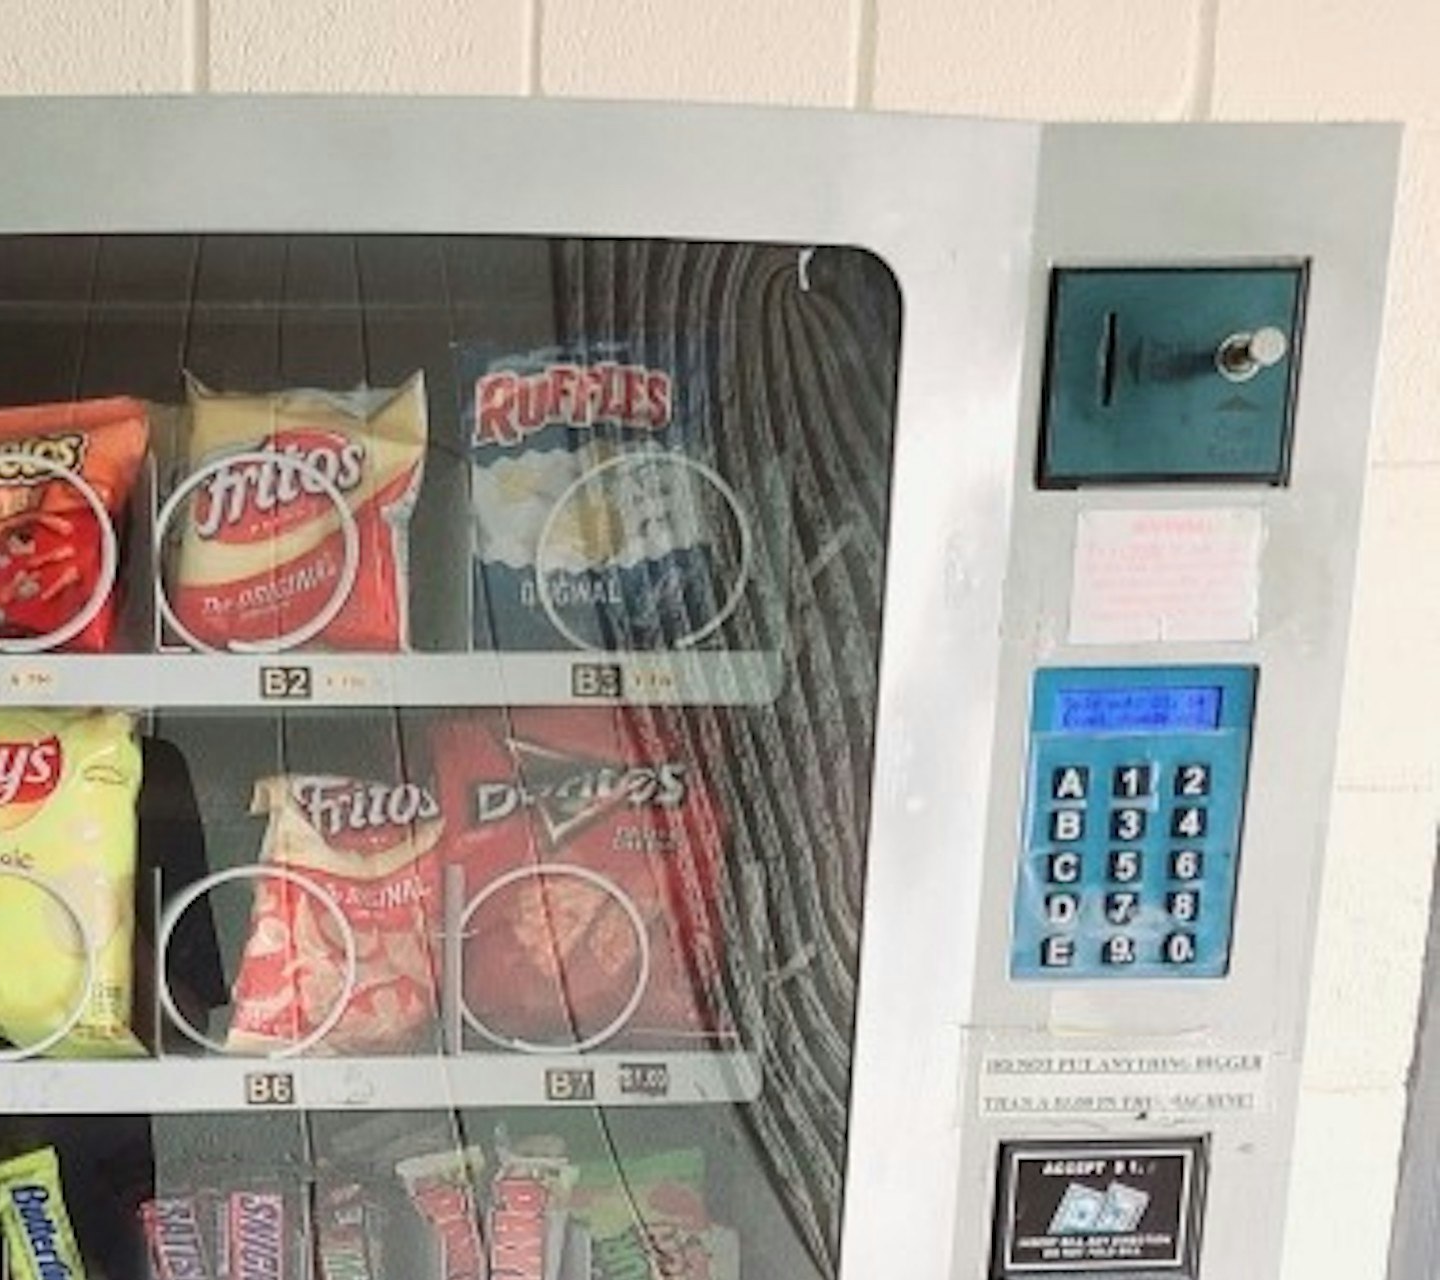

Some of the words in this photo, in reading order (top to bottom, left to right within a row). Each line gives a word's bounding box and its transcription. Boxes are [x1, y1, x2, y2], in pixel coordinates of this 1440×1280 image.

[472, 360, 673, 447] RUFFLES
[197, 443, 365, 538] Fritos
[264, 669, 308, 697] B2
[575, 667, 620, 696] B3
[1057, 769, 1084, 798] A
[1121, 768, 1140, 796] 1
[1182, 767, 1203, 795] 2
[292, 776, 441, 836] Fritos
[1056, 810, 1080, 838] B
[1118, 809, 1141, 839] 3
[1177, 809, 1200, 837] 4
[1053, 854, 1078, 882] C
[1116, 852, 1137, 880] 5
[1175, 851, 1197, 878] 6
[1049, 896, 1077, 924] D
[1113, 893, 1136, 923] 7
[1172, 893, 1193, 920] 8
[1047, 936, 1071, 965] E
[1110, 936, 1133, 962] 9
[1170, 934, 1192, 962] 0
[250, 1076, 290, 1103] B6
[1042, 1160, 1107, 1176] ACCEPT
